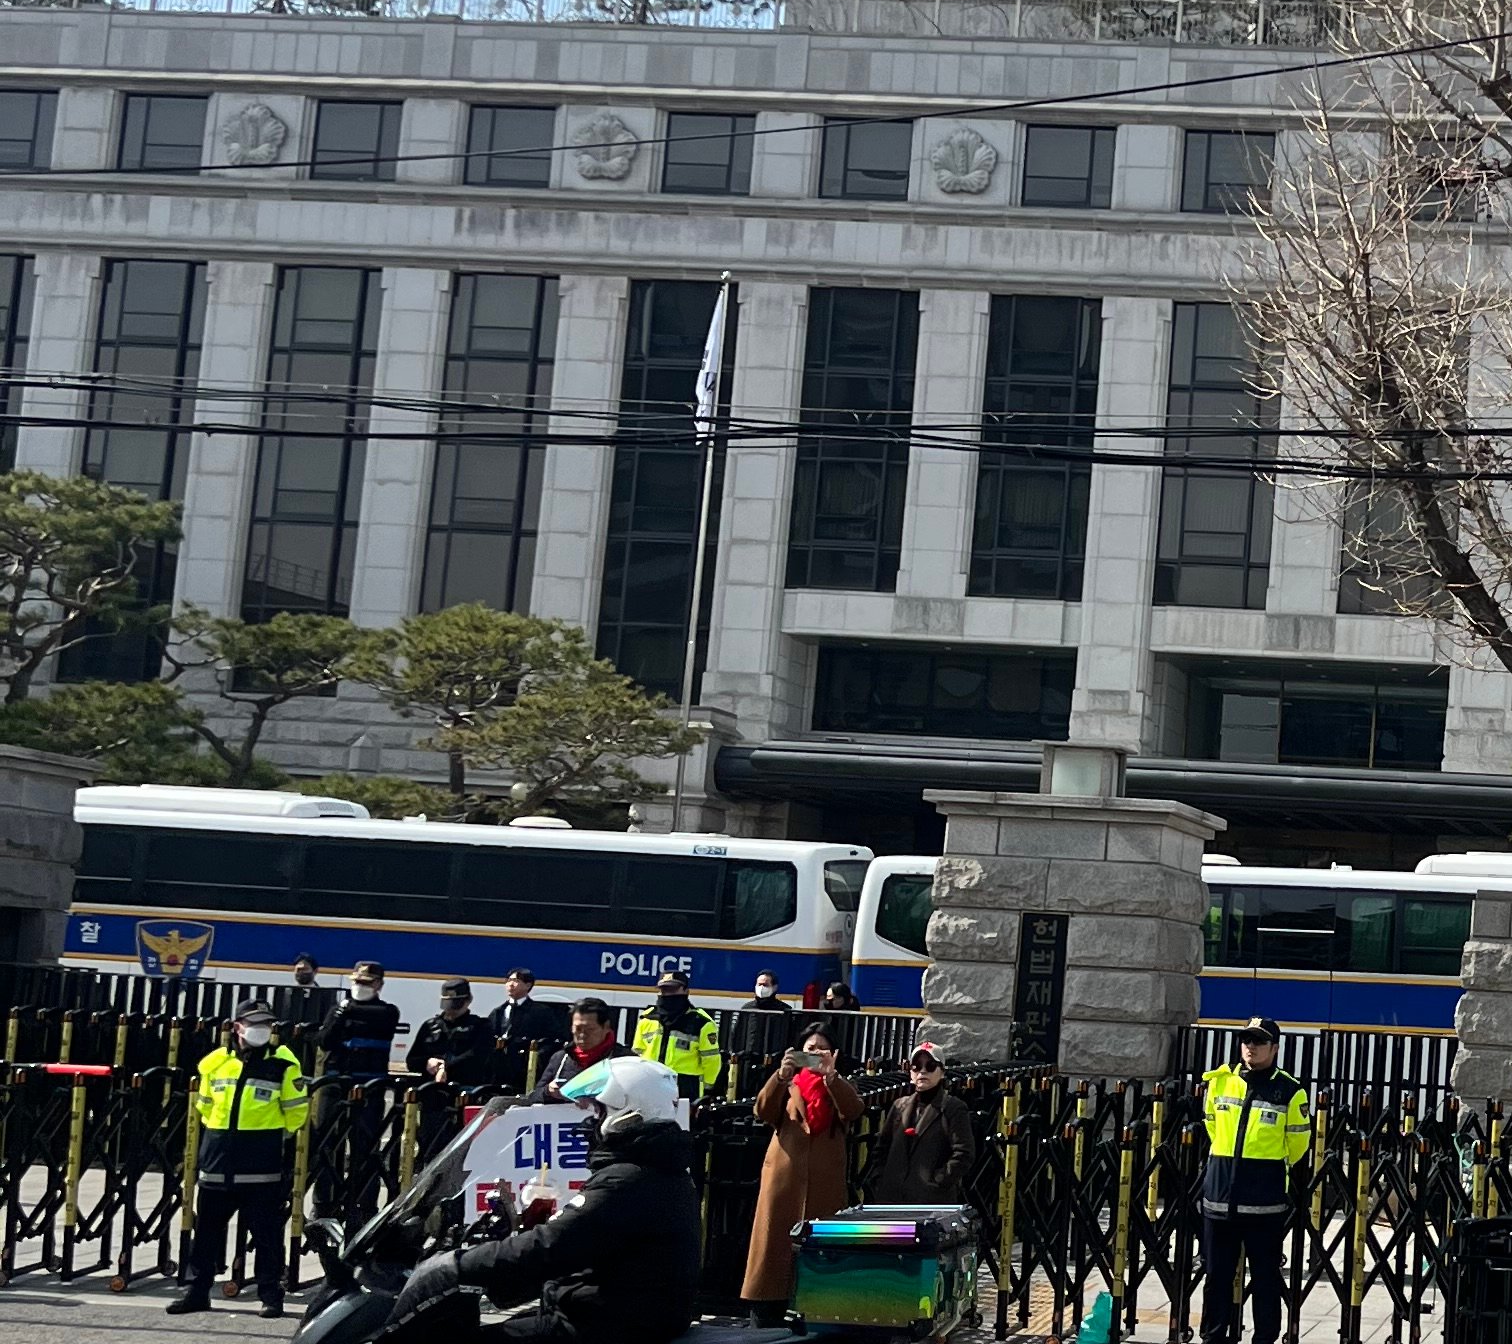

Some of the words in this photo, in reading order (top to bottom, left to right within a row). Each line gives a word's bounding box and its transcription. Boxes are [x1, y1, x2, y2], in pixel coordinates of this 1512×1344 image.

[79, 920, 102, 944] 찰
[600, 951, 693, 979] POLICE
[1022, 918, 1058, 1060] 헌법재판소
